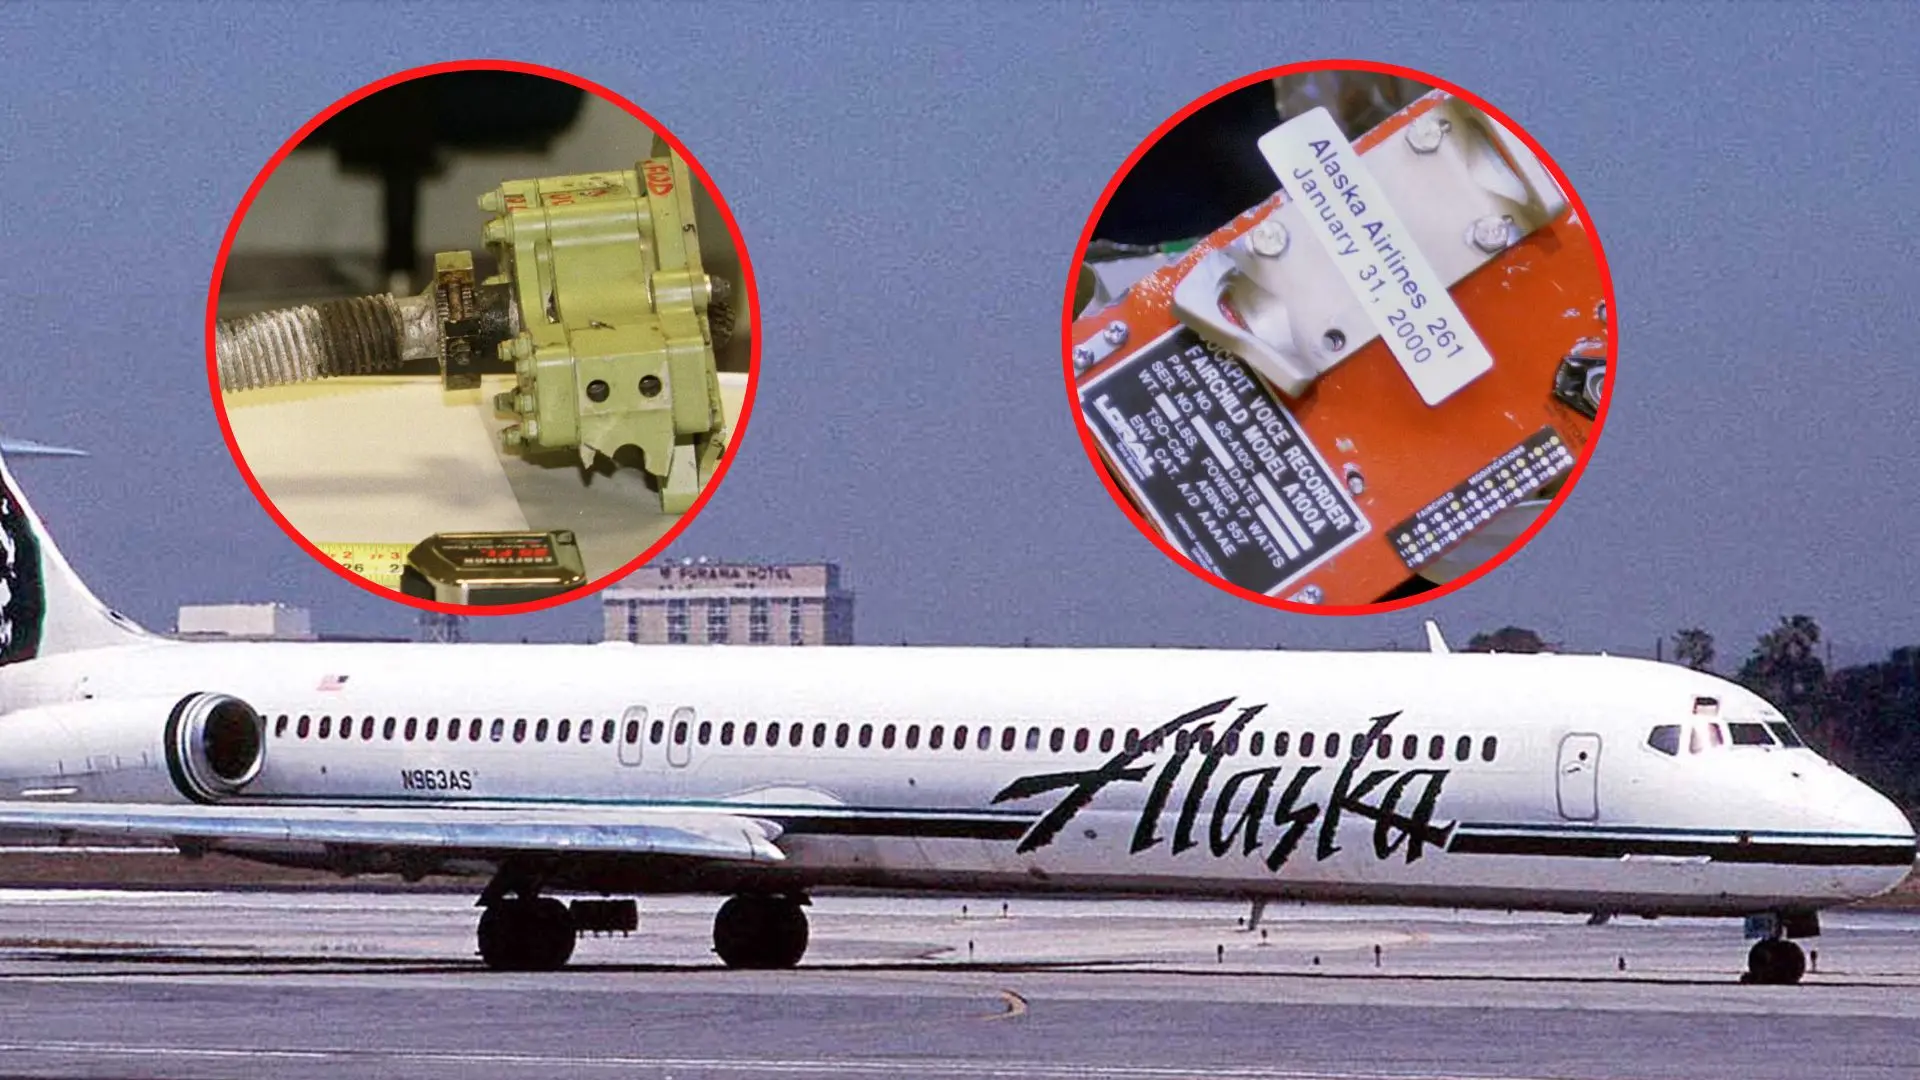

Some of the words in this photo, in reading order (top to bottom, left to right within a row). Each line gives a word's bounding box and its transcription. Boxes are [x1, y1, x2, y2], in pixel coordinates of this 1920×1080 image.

[1293, 168, 1360, 256] January
[1359, 264, 1386, 303] 31,
[1387, 308, 1432, 363] 2000
[1308, 140, 1366, 217] Alaska
[1361, 221, 1427, 309] Airlines
[1426, 317, 1464, 358] 261
[1094, 394, 1154, 477] LORAL
[1129, 414, 1155, 446] ENV.
[1154, 448, 1180, 479] CAT.
[1177, 483, 1201, 507] A/D
[1198, 511, 1236, 557] AAAAE
[1138, 369, 1160, 395] WT.
[1174, 420, 1198, 450] LBS.
[1201, 457, 1239, 504] POWER
[1236, 506, 1251, 518] 17
[1248, 521, 1285, 568] WATTS
[1146, 407, 1191, 465] TSO-C84
[1196, 480, 1229, 518] ARINC
[1226, 521, 1249, 543] 557
[1151, 361, 1176, 391] SER.
[1174, 392, 1194, 417] NO.
[1229, 467, 1260, 505] DATE
[1167, 354, 1198, 388] PART
[1193, 390, 1212, 414] NO.
[1215, 420, 1255, 473] 93-A100-
[1185, 346, 1249, 424] FAIRCHILD
[1242, 424, 1287, 481] MODEL
[1282, 483, 1326, 534] A100A
[1207, 340, 1256, 394] OCKPIT
[1249, 396, 1291, 446] VOICE
[1283, 445, 1351, 530] RECORDER
[401, 770, 473, 790] N963AS
[991, 696, 1457, 873] Alaska
